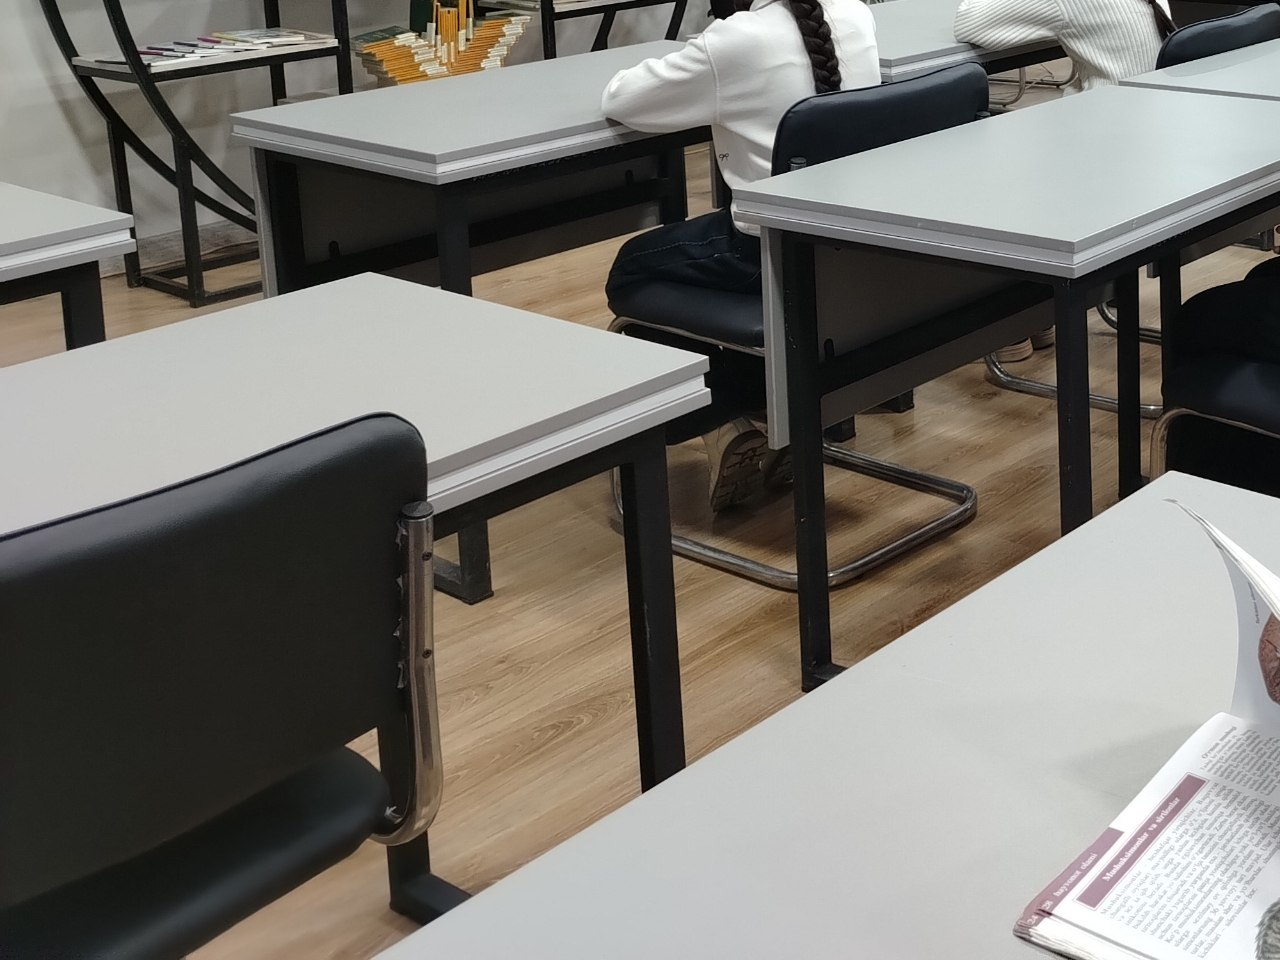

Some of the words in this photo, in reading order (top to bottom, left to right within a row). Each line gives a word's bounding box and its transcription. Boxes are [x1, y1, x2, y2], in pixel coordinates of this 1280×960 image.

[1102, 831, 1149, 883] Mushuksimonlar
[1148, 820, 1159, 832] va
[1155, 796, 1181, 825] sirtlonlar
[1053, 869, 1082, 898] hayvonot
[1080, 852, 1098, 872] olami
